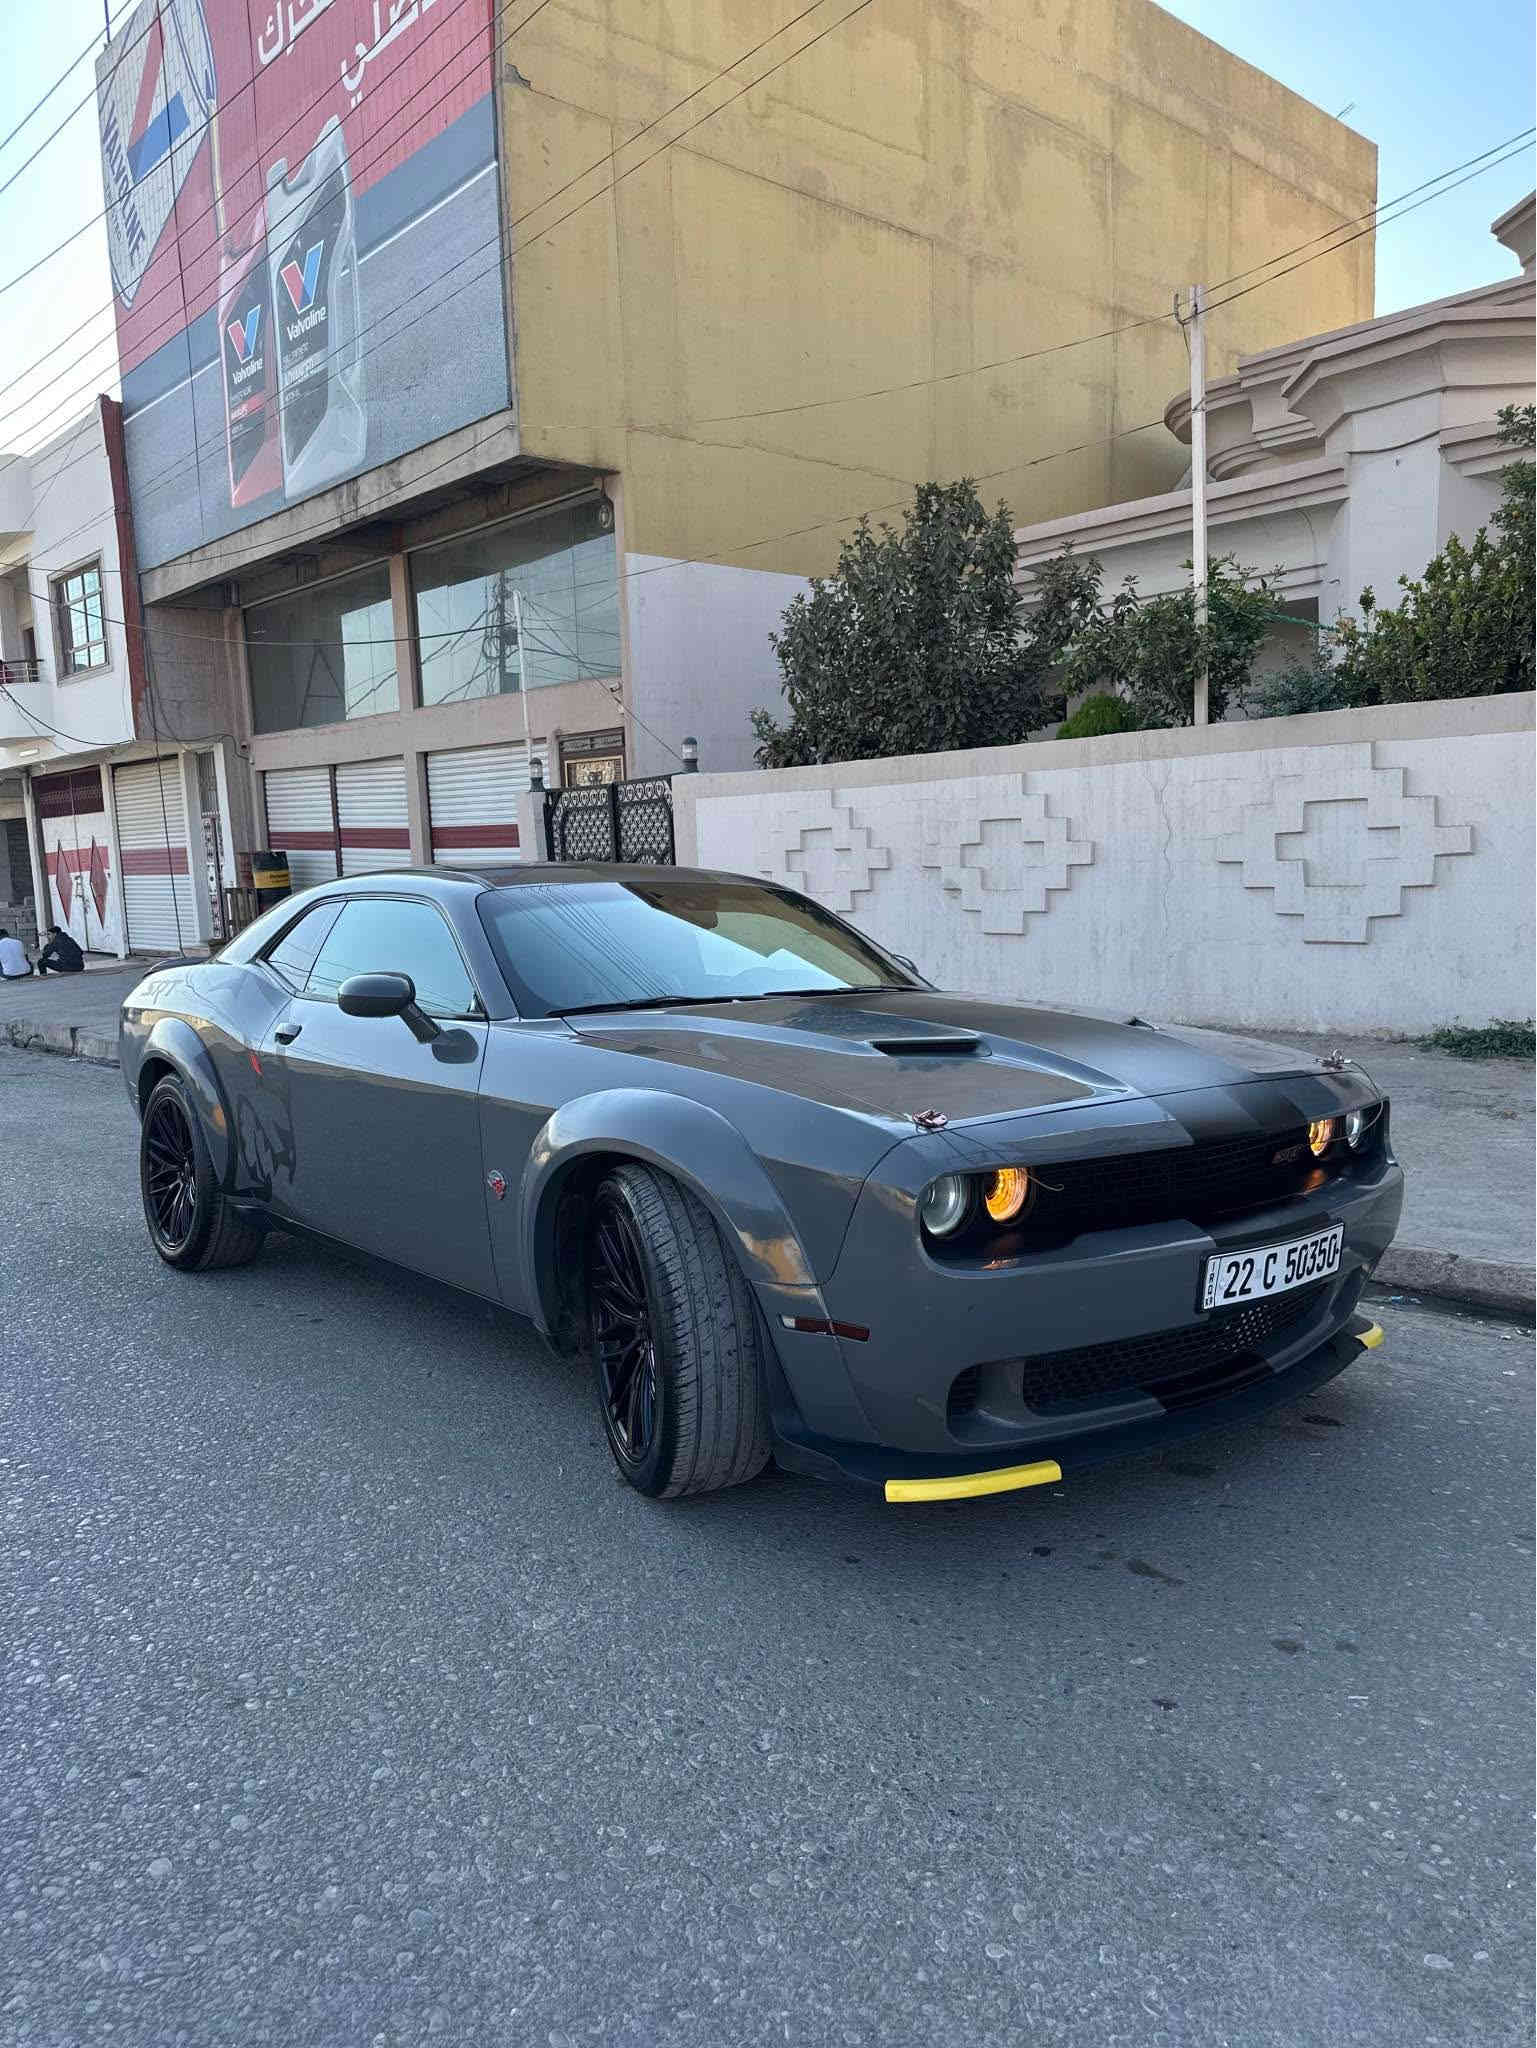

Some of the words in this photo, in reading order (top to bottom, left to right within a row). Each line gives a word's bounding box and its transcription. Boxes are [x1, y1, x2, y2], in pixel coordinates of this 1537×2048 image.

[286, 306, 329, 341] Valvoline
[231, 358, 264, 385] Valvoline
[1223, 1258, 1255, 1299] 22
[1263, 1252, 1278, 1290] C
[1284, 1233, 1338, 1284] 50350
